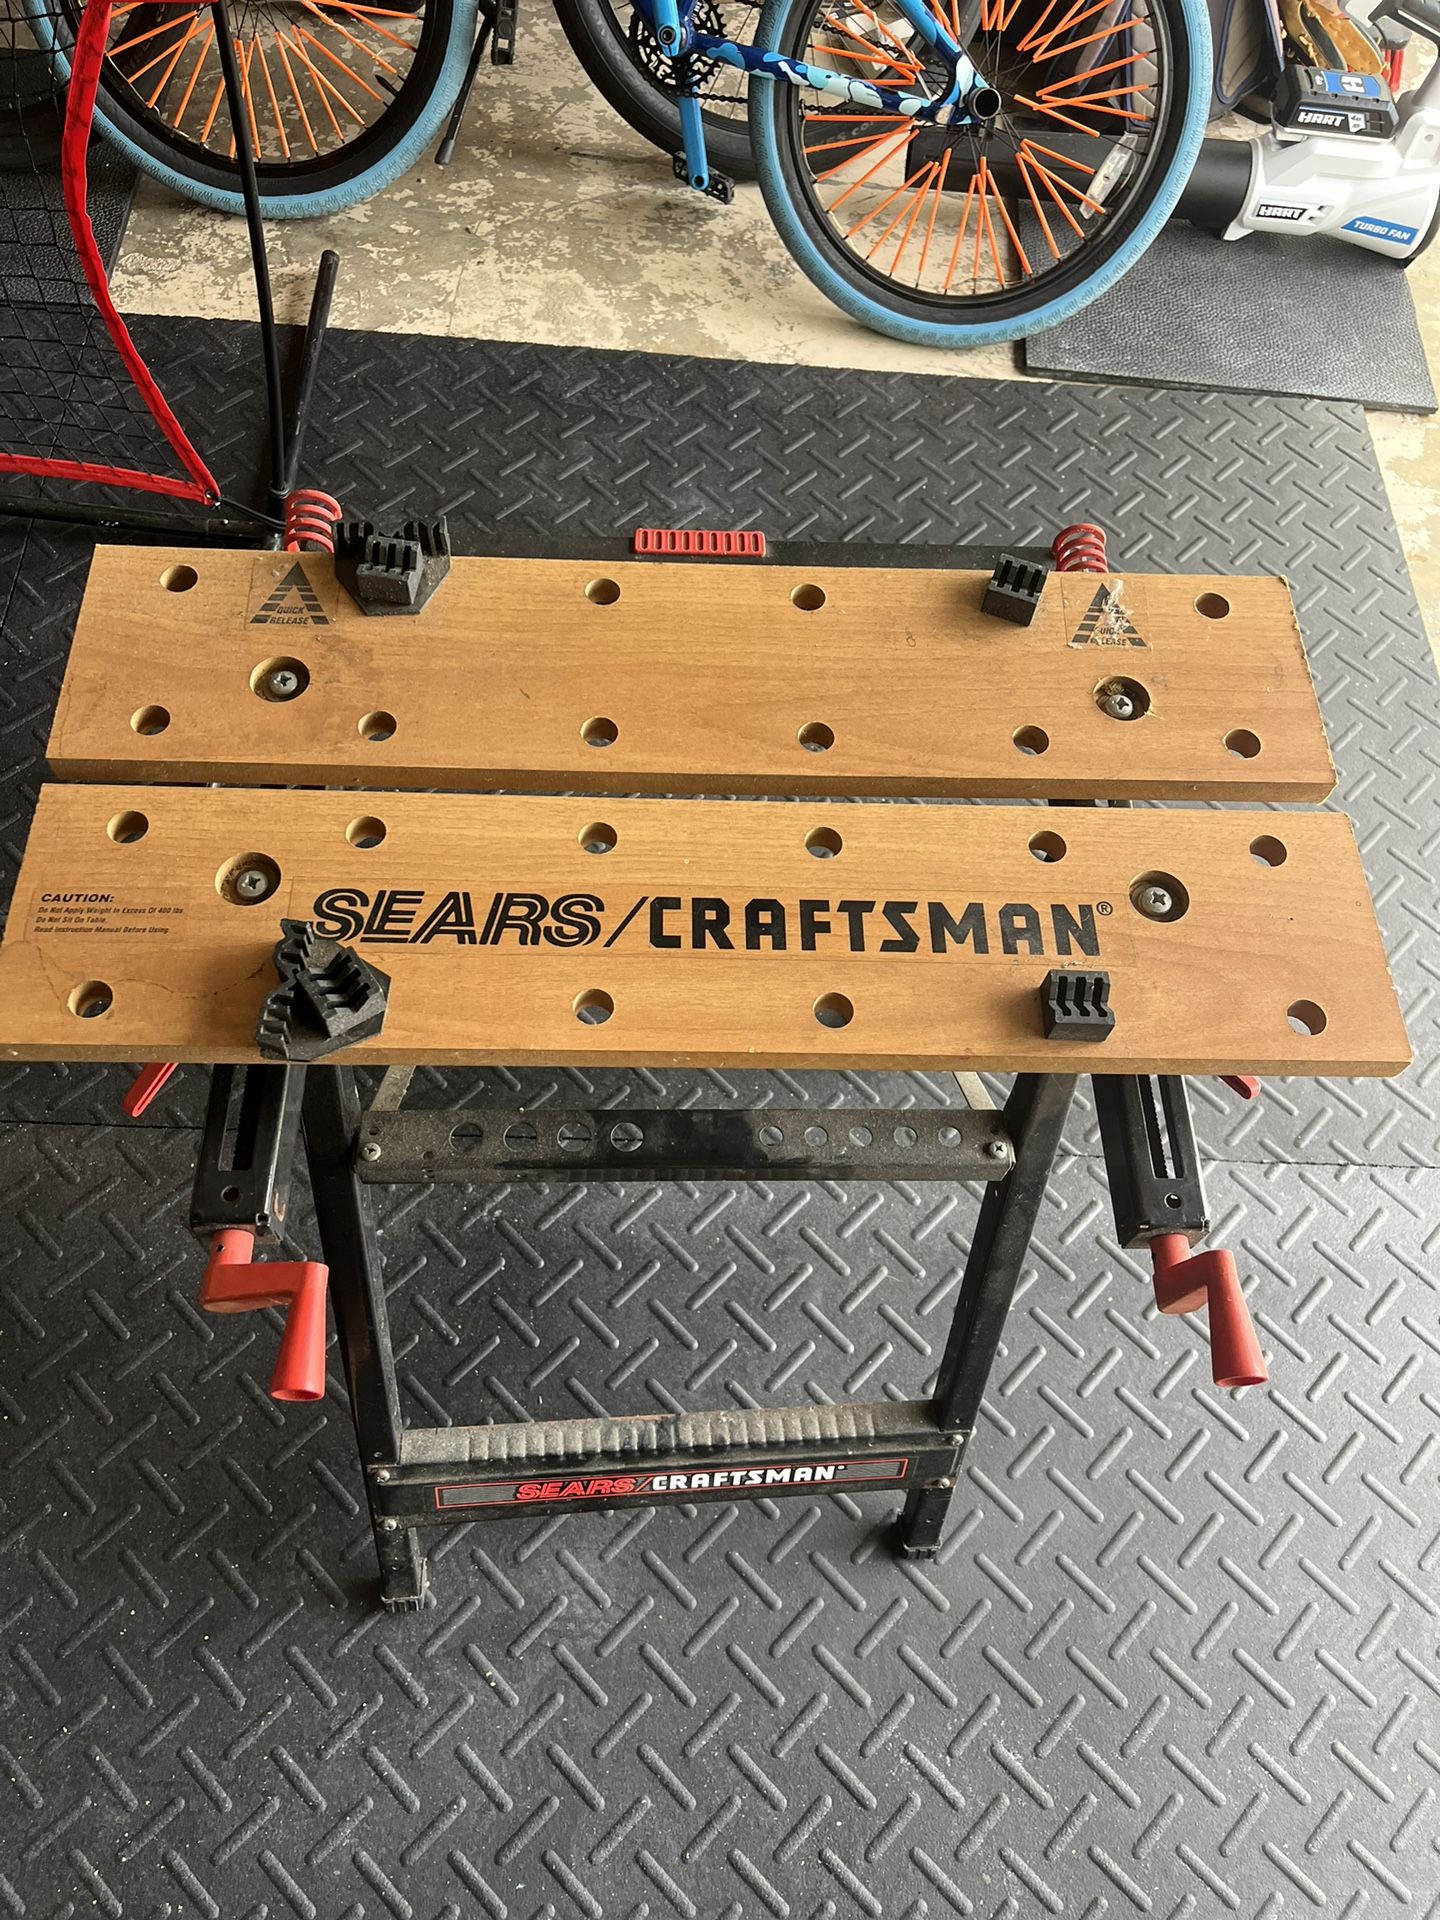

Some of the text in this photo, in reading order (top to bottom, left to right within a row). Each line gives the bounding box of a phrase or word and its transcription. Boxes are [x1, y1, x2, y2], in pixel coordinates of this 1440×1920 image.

[1297, 111, 1345, 127] HART
[1258, 205, 1304, 220] HART
[1354, 220, 1412, 241] TURBO FAN
[276, 606, 305, 615] QUICK
[269, 616, 311, 625] RELEASE
[41, 893, 115, 903] CAUTION:
[38, 906, 49, 914] Do
[50, 906, 63, 914] Not
